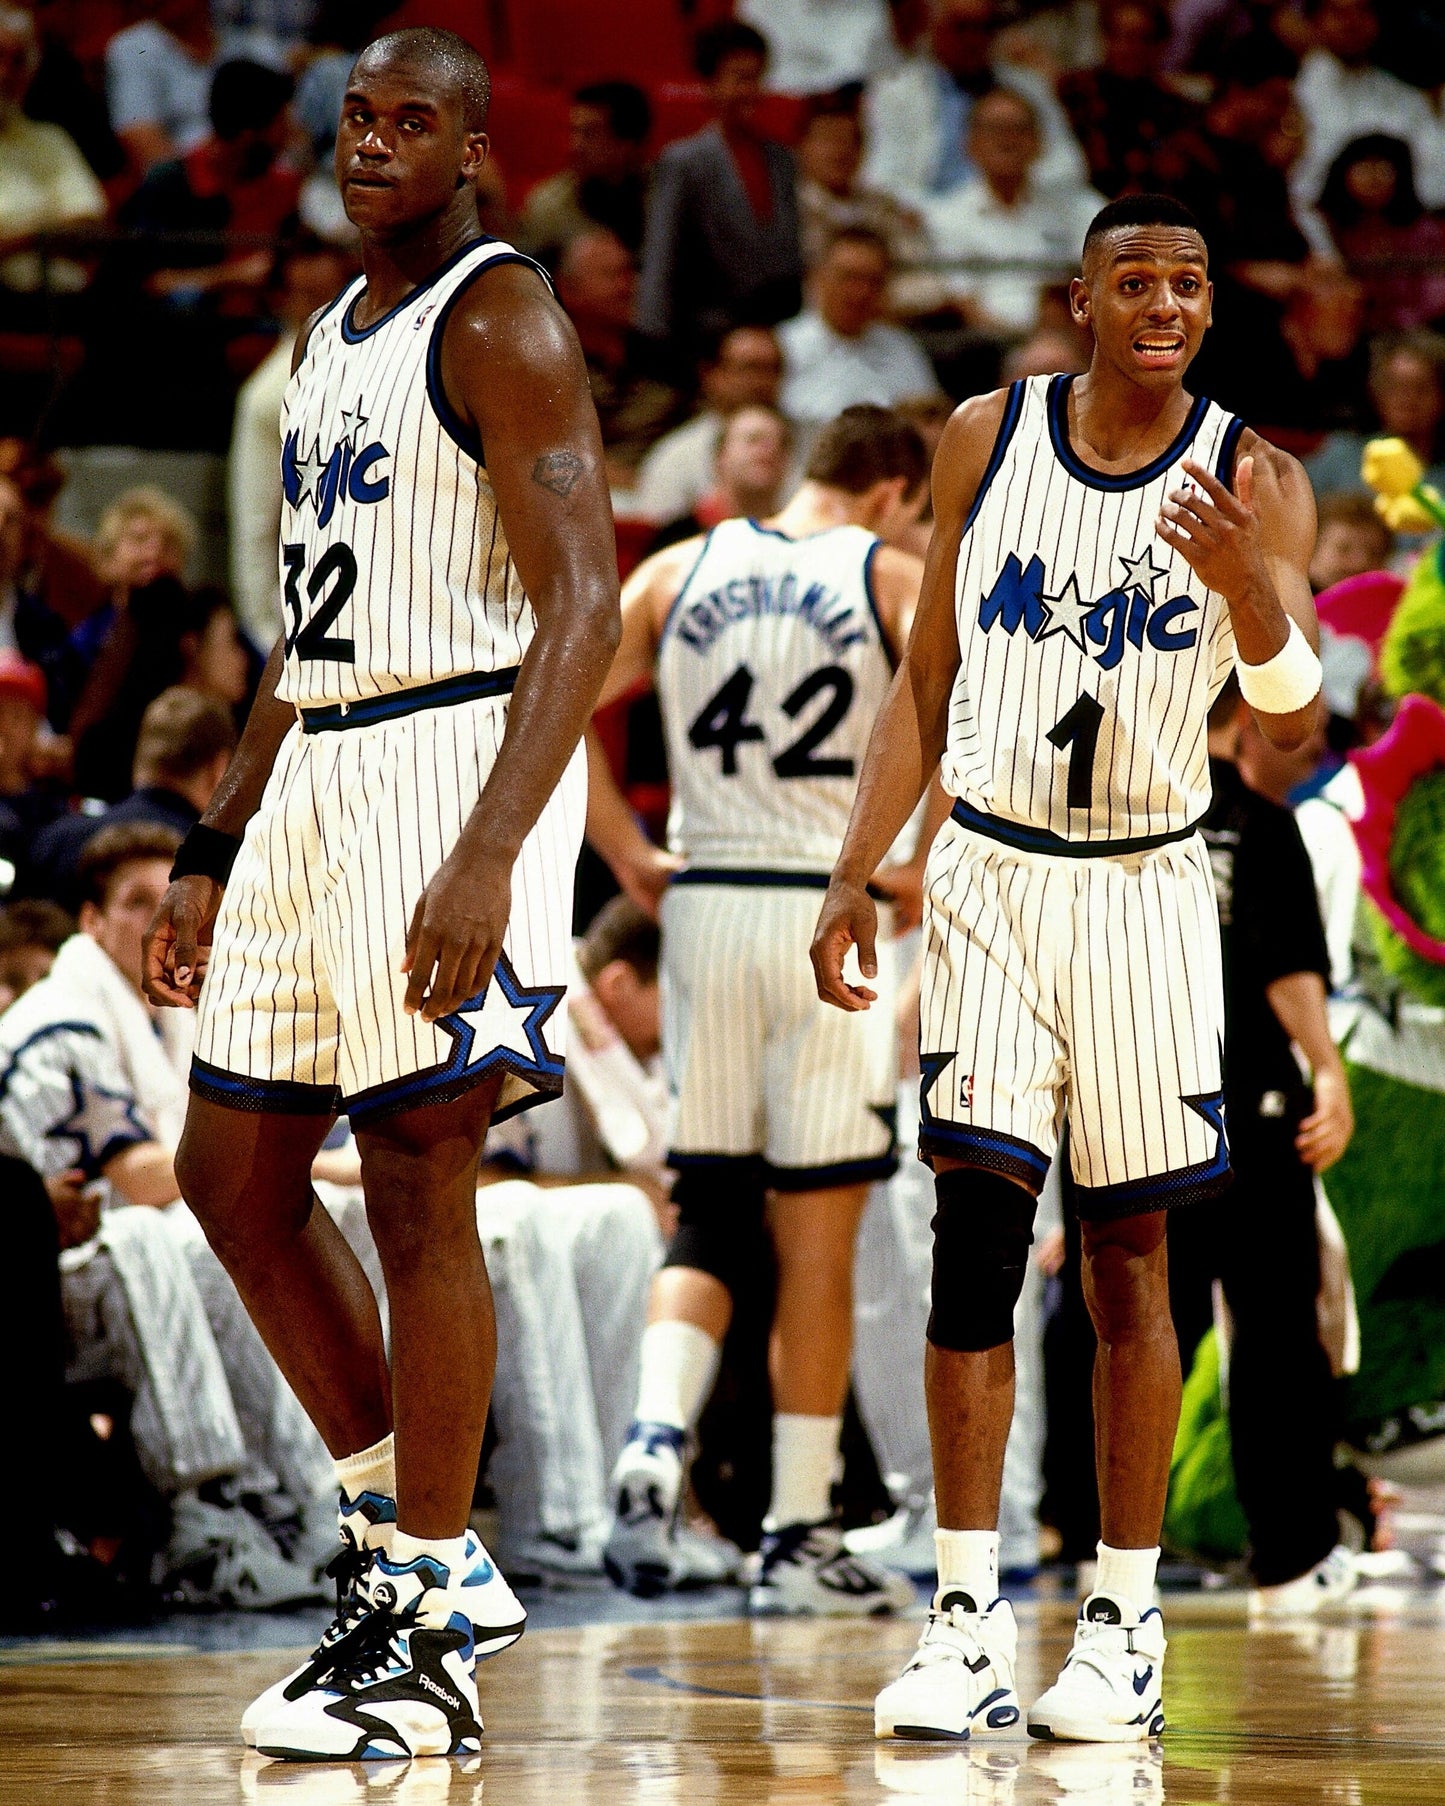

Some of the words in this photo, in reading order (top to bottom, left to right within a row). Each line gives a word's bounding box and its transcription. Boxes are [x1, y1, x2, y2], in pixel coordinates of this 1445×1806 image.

[284, 542, 357, 664] 32
[688, 661, 855, 777] 42
[1045, 689, 1105, 809] 1
[418, 1672, 461, 1711] Reebok
